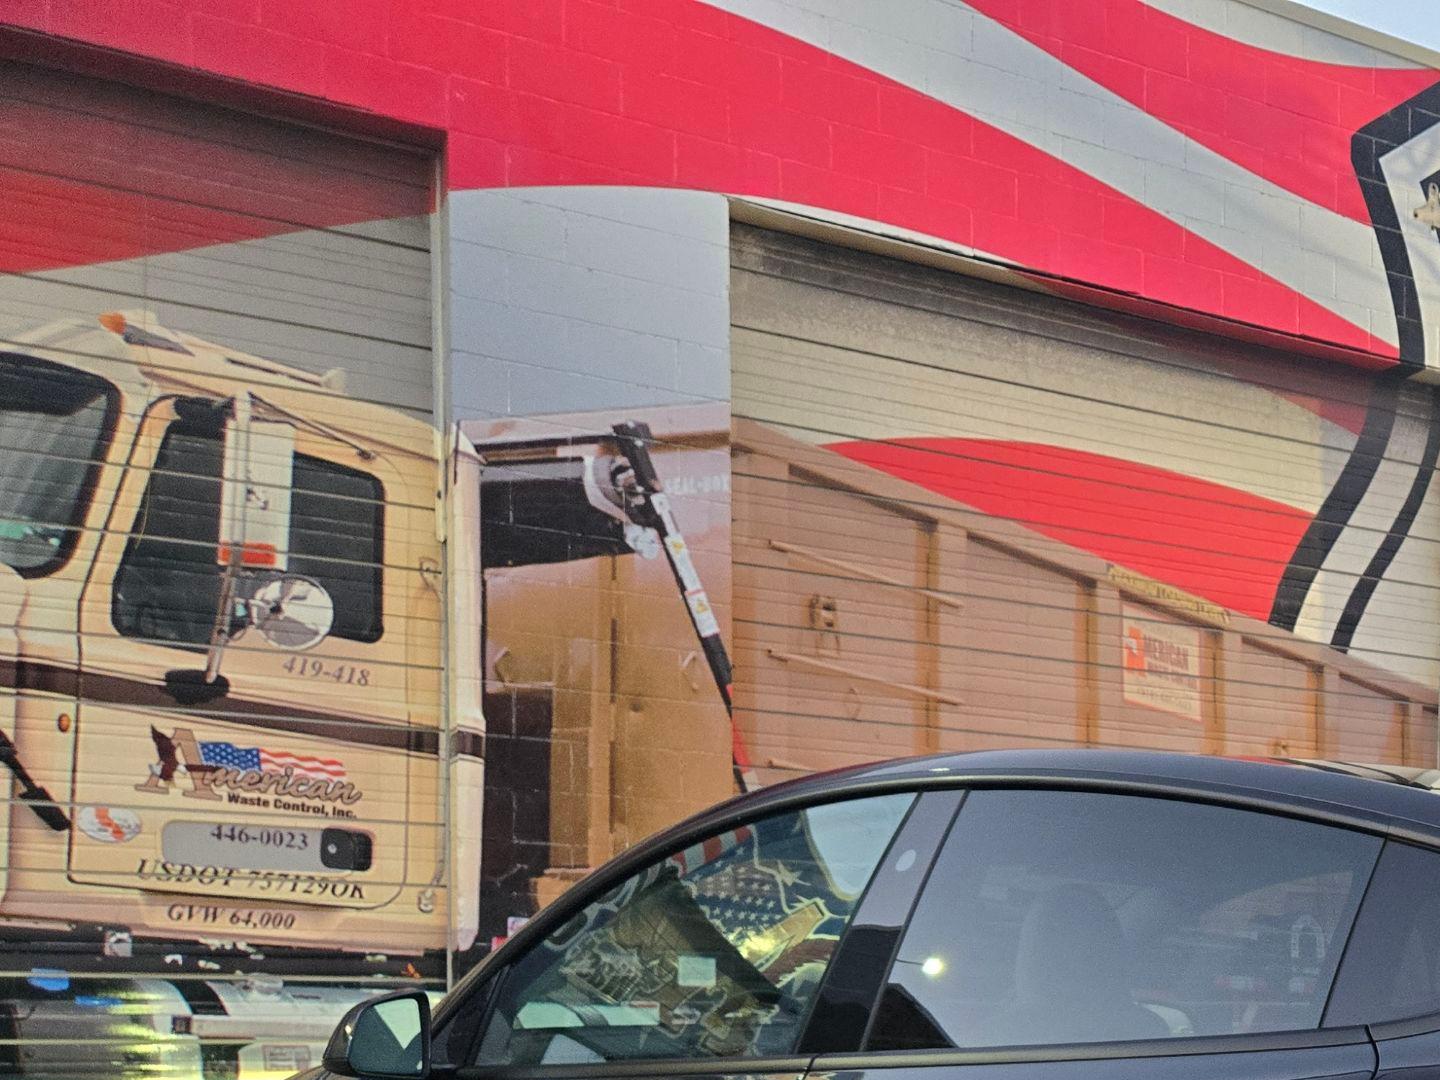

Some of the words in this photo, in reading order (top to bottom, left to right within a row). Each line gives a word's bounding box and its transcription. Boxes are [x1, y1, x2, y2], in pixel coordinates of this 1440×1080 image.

[283, 655, 371, 687] 419-418
[134, 726, 362, 805] American
[227, 792, 271, 809] Waste
[274, 798, 329, 818] Control,
[332, 805, 357, 819] Inc.
[210, 824, 309, 851] 446-0023
[136, 858, 240, 886] USDOT
[167, 903, 221, 924] GVW
[229, 911, 296, 930] 64,000
